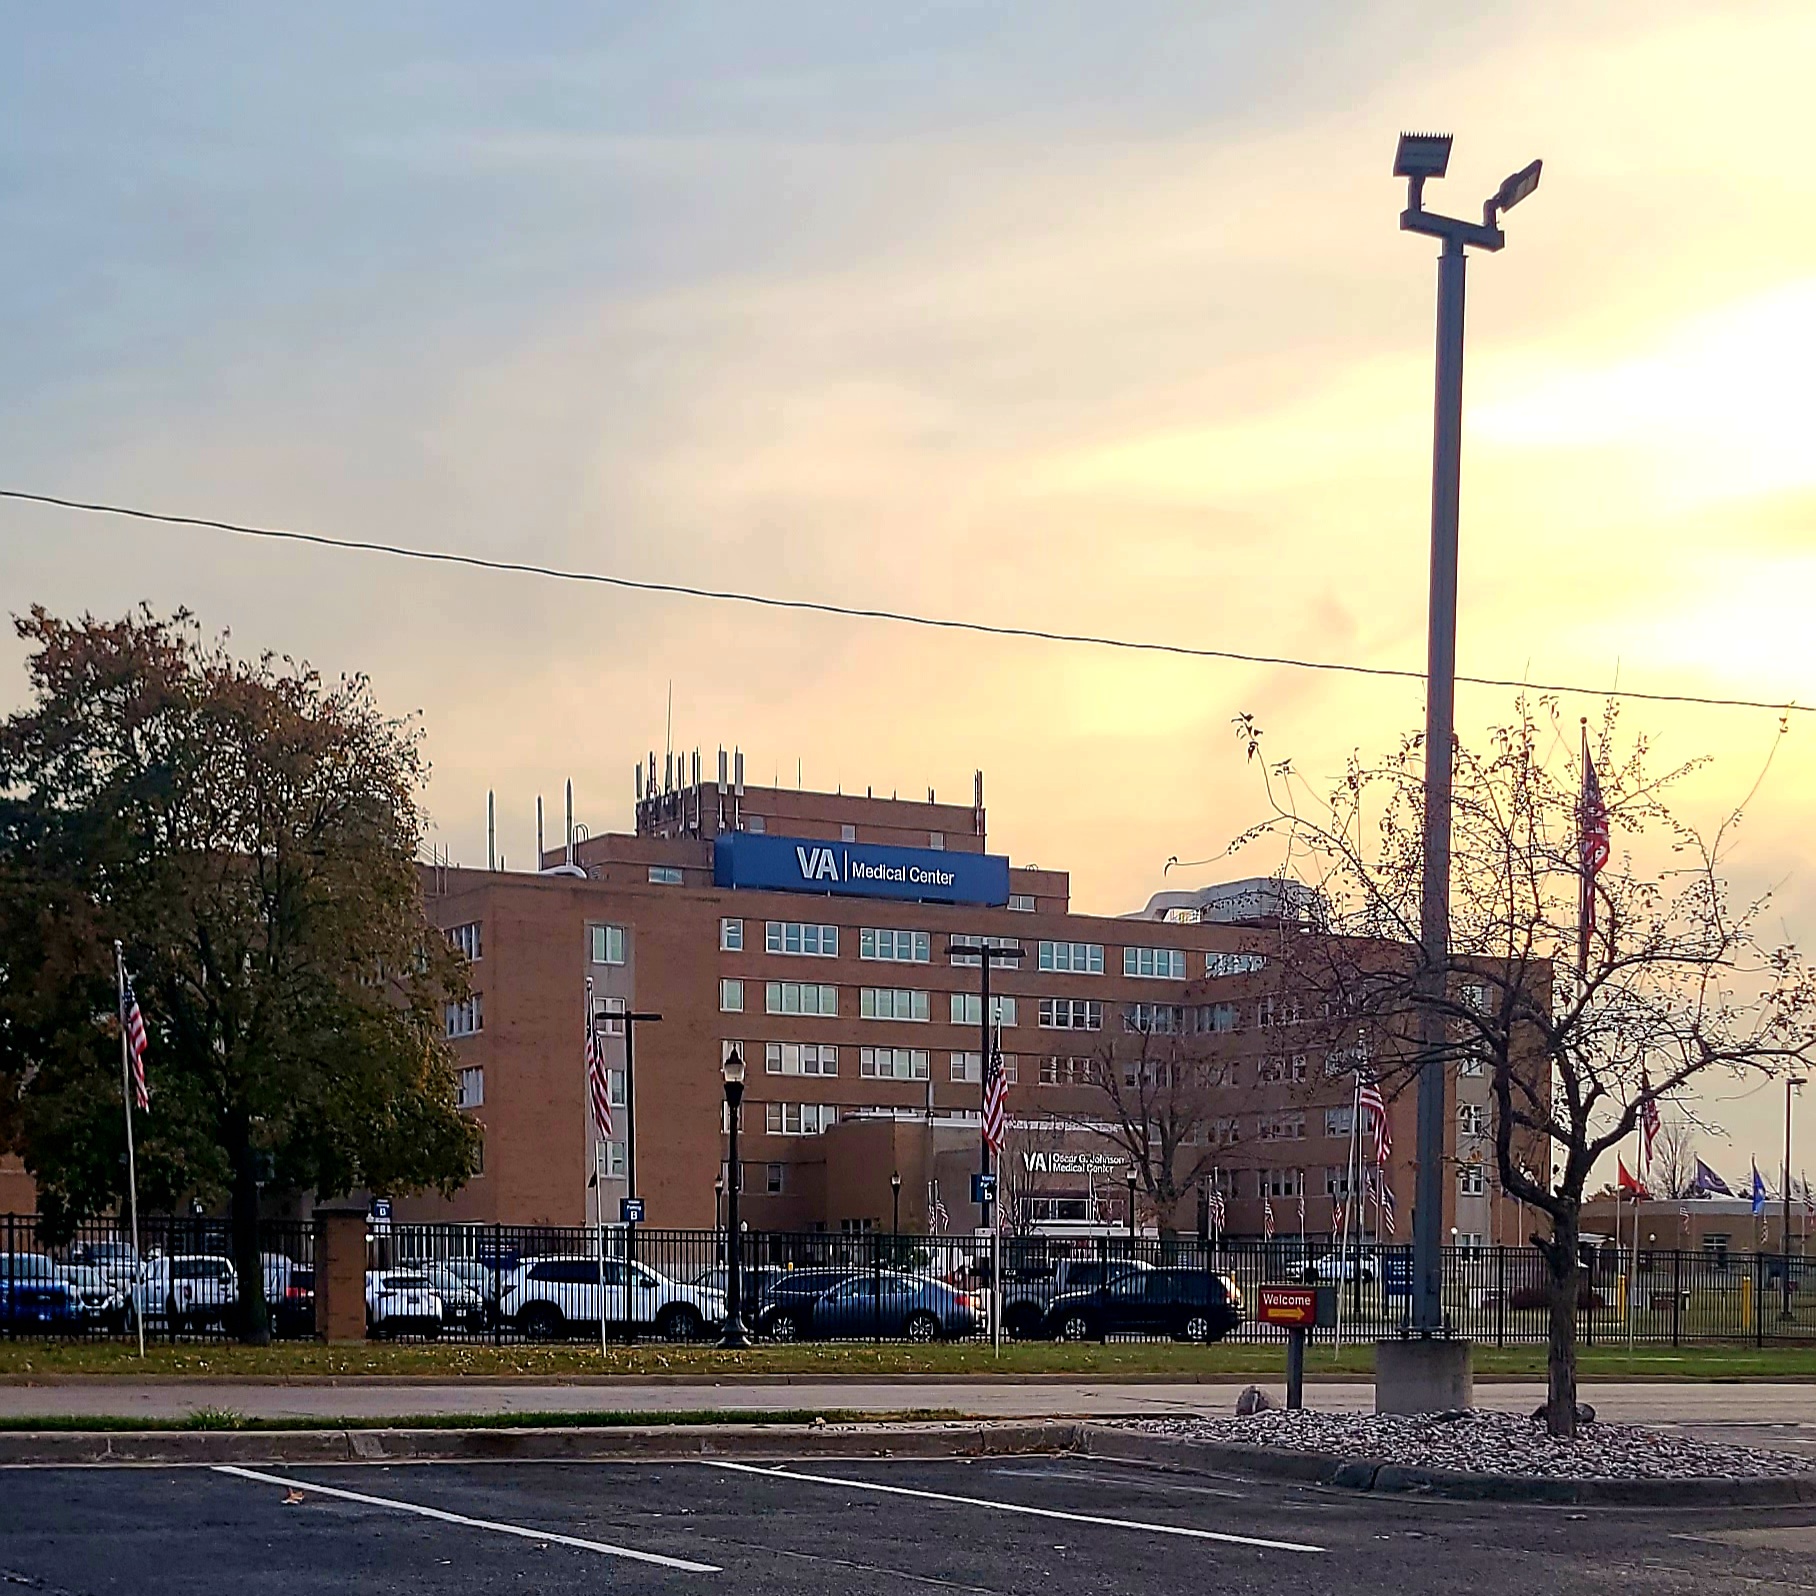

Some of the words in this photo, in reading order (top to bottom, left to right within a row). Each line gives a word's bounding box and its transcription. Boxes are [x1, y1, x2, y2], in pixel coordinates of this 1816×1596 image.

[796, 846, 839, 882] VA
[852, 861, 906, 883] Medical
[909, 866, 955, 887] Center
[1023, 1152, 1047, 1172] VA
[1053, 1153, 1078, 1163] Oscar
[1090, 1154, 1125, 1165] Johnson
[1053, 1162, 1085, 1173] Medical
[1086, 1164, 1114, 1174] Center
[630, 1210, 638, 1221] B
[1263, 1293, 1311, 1306] Welcome
